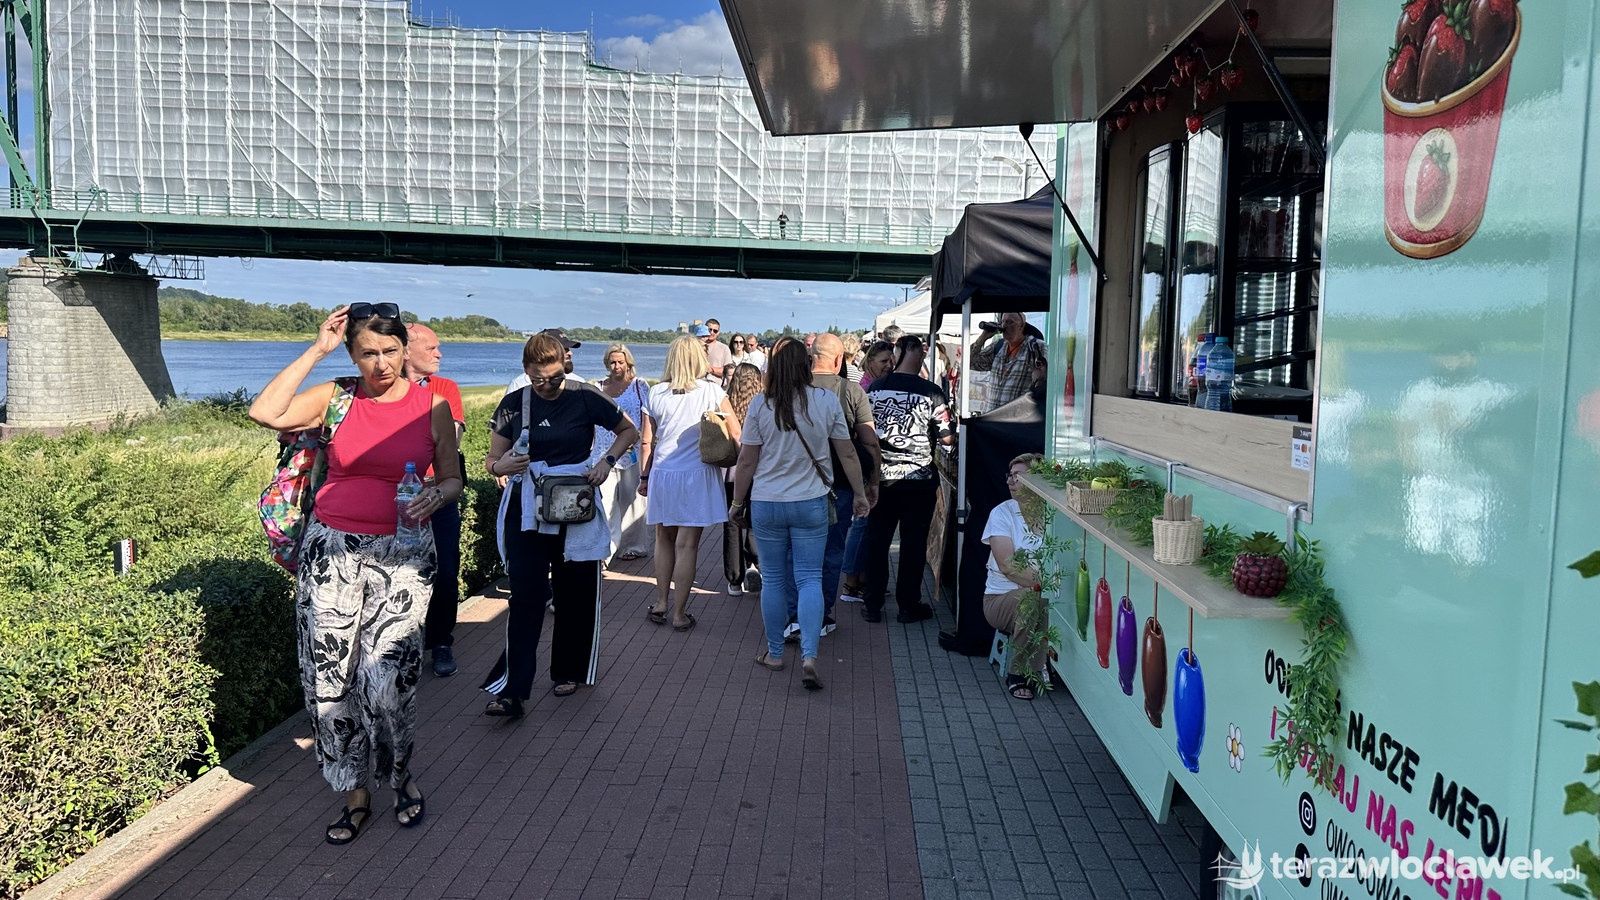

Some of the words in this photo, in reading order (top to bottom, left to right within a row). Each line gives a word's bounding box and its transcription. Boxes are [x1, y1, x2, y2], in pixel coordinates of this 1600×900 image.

[1271, 706, 1278, 740] I
[1366, 790, 1415, 859] NAS
[1347, 710, 1420, 793] NASZE
